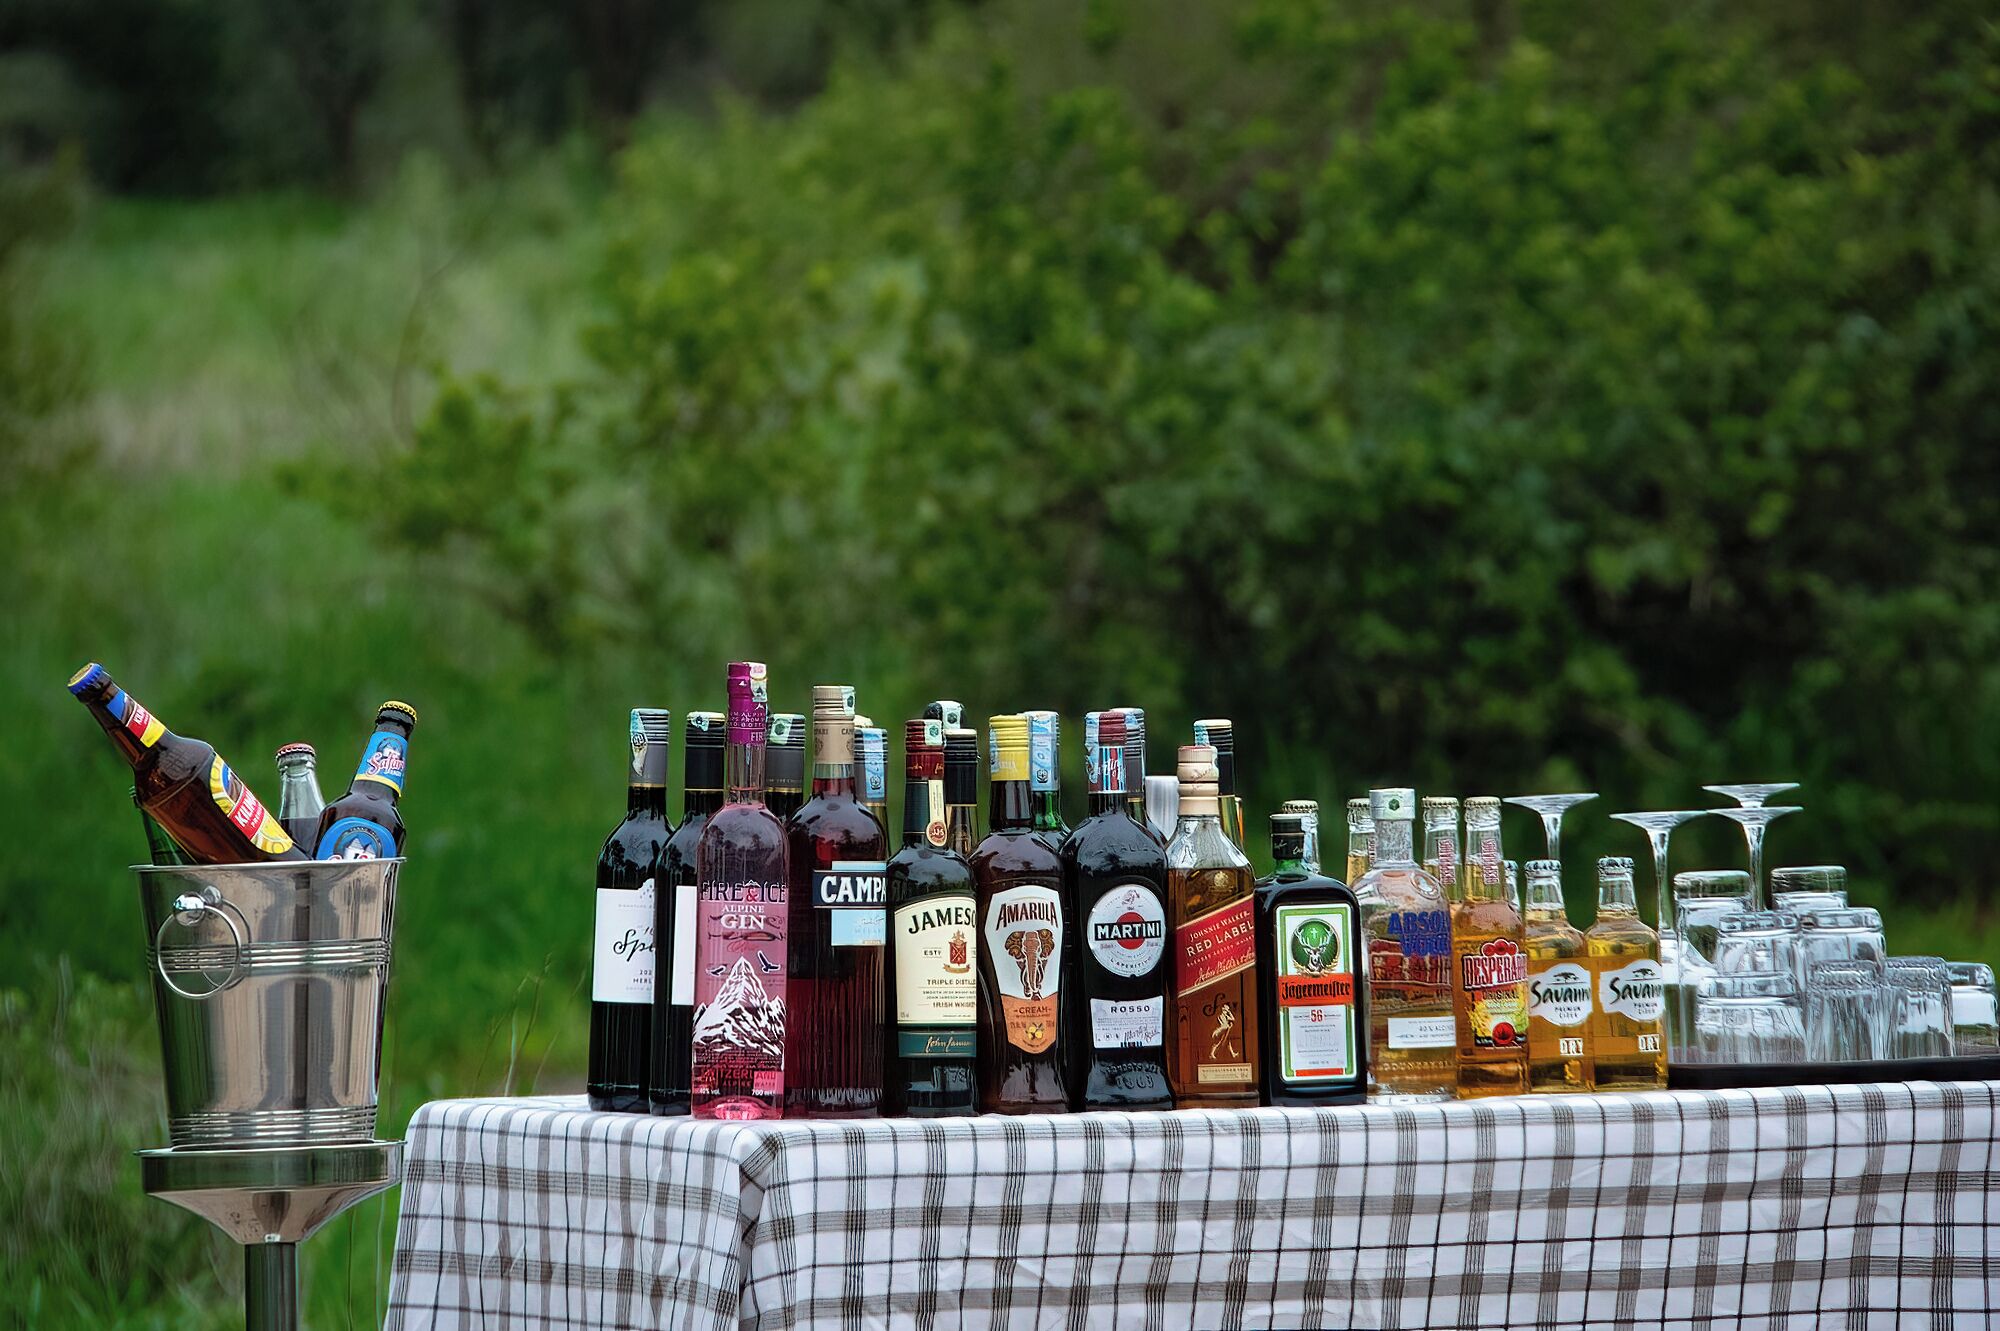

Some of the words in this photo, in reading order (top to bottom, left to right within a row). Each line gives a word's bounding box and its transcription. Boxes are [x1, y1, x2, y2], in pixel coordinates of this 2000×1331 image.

[721, 904, 766, 914] ALPINE
[995, 902, 1059, 931] AMARULA
[720, 913, 767, 930] GIN
[1189, 922, 1221, 943] JOHNNIE
[1220, 909, 1251, 927] WALKER
[1097, 922, 1160, 939] MARTINI
[1186, 938, 1213, 957] RED
[1215, 920, 1255, 944] LABEL
[1018, 1006, 1048, 1015] CREAM
[1110, 1005, 1150, 1014] ROSSO
[1310, 1009, 1324, 1023] 56
